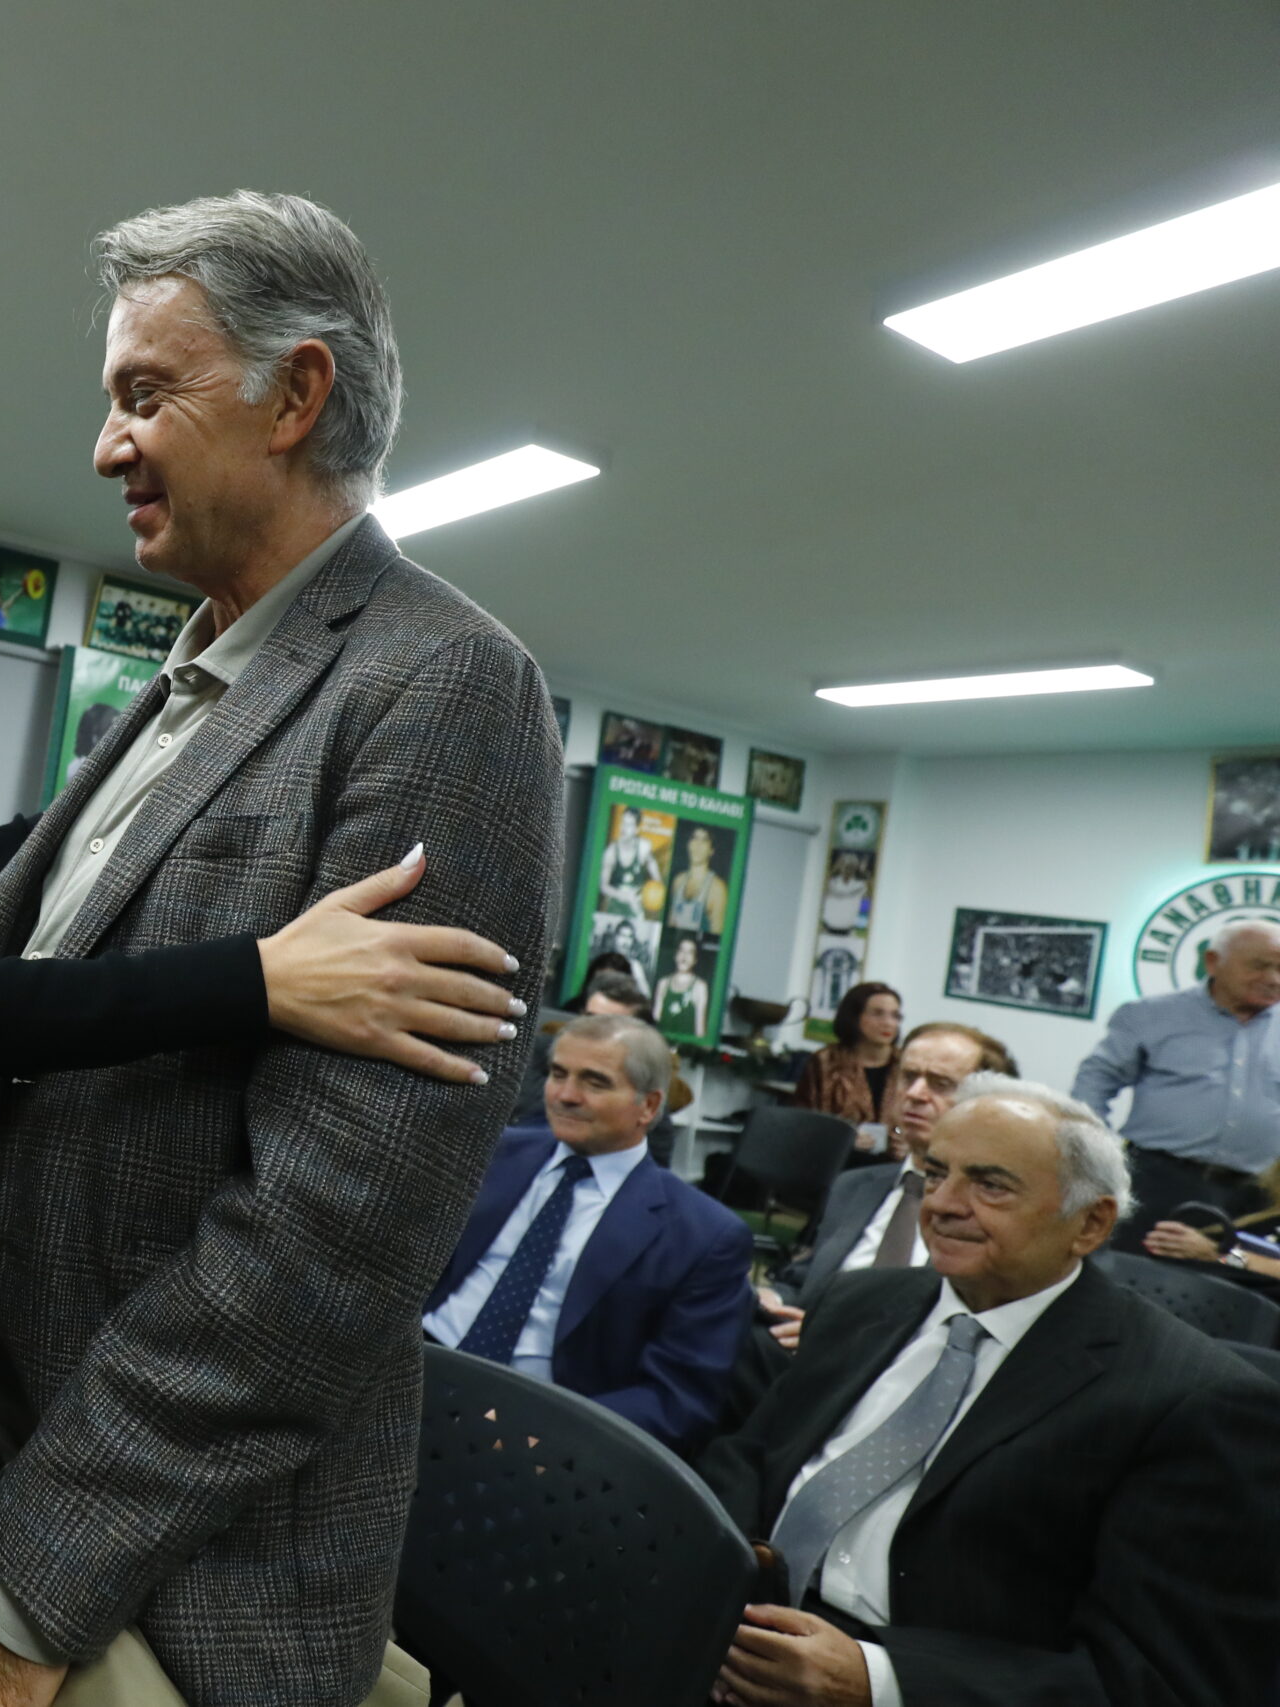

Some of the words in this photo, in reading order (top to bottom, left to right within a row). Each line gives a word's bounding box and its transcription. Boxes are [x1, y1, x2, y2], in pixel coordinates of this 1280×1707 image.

[118, 675, 147, 693] ΠΑ
[609, 775, 657, 801] ΕΡΩΤΑΣ
[659, 785, 679, 805] ΜΕ
[680, 789, 698, 809] ΤΟ
